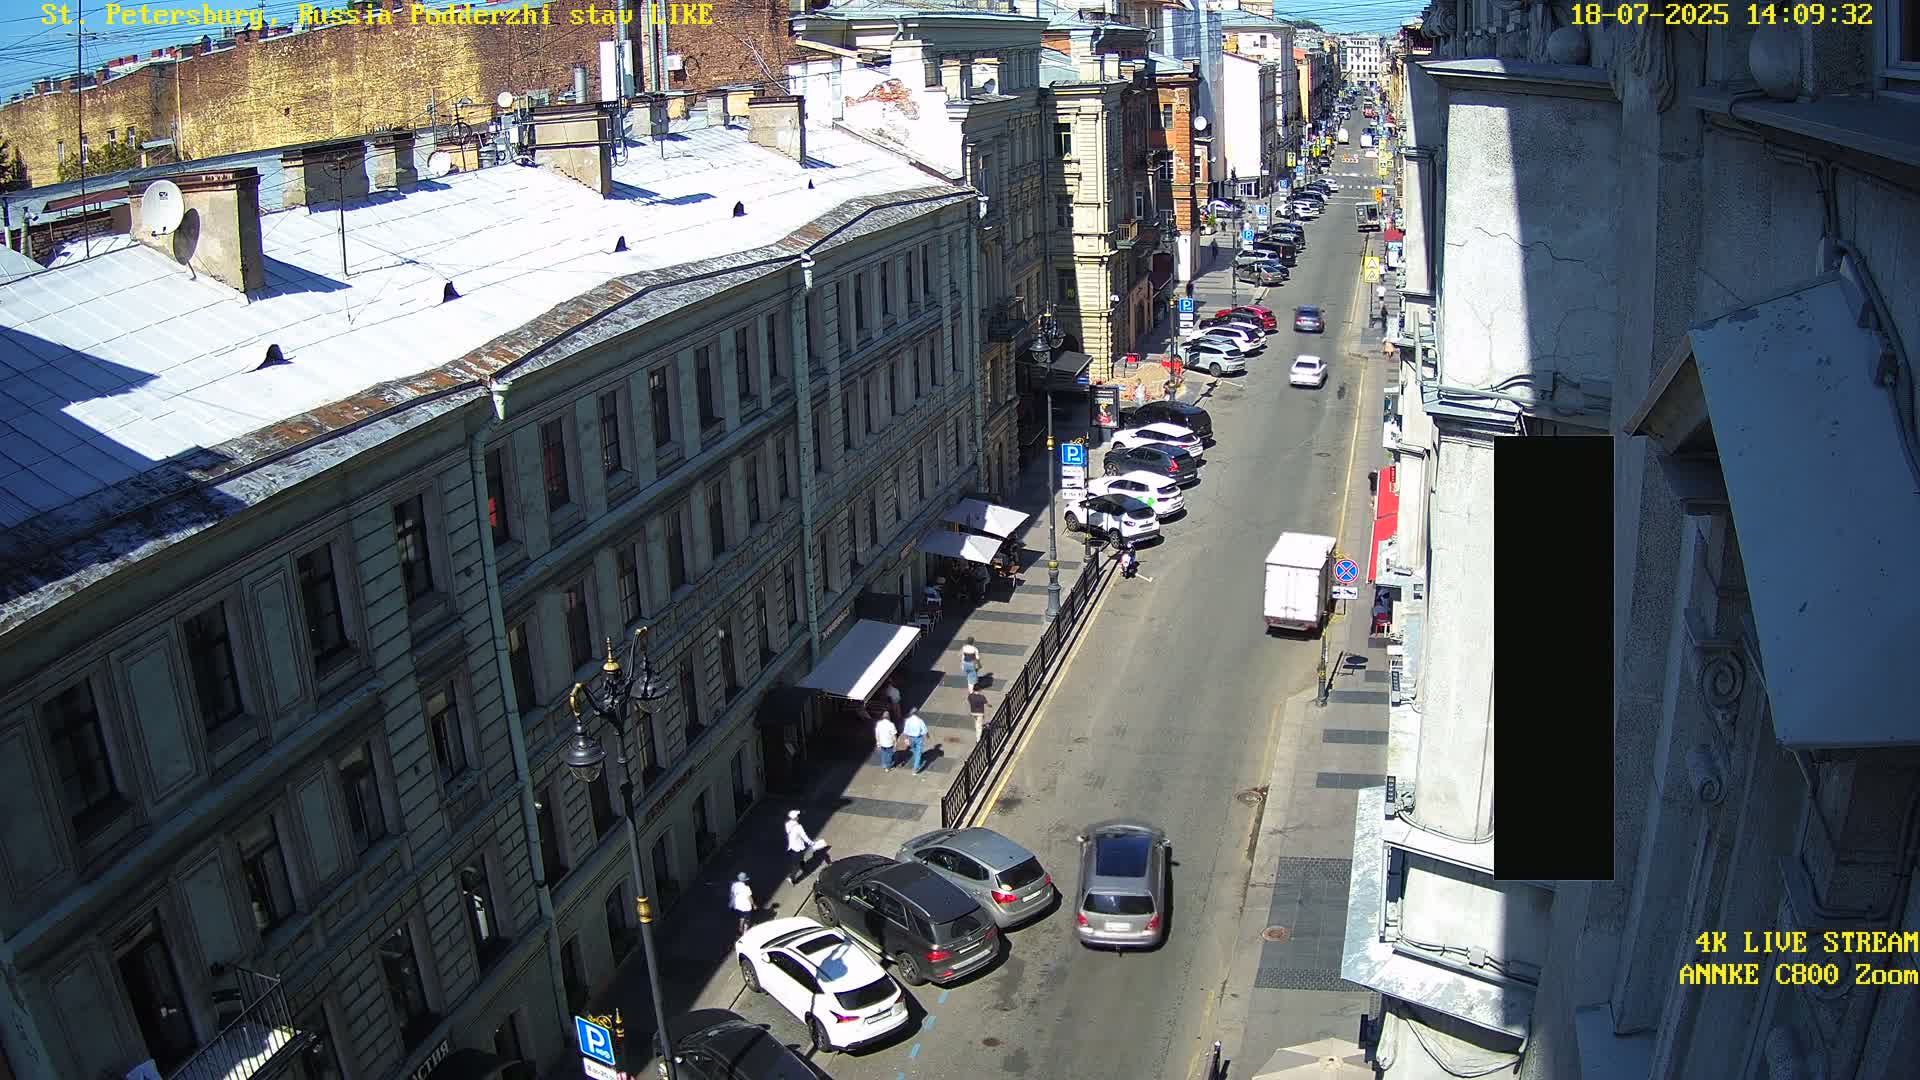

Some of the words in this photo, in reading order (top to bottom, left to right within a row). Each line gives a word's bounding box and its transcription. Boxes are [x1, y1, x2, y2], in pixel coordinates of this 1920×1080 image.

[1183, 300, 1191, 311] P
[1067, 446, 1079, 462] P
[585, 1024, 605, 1053] P
[412, 1039, 449, 1080] СТИЯ
